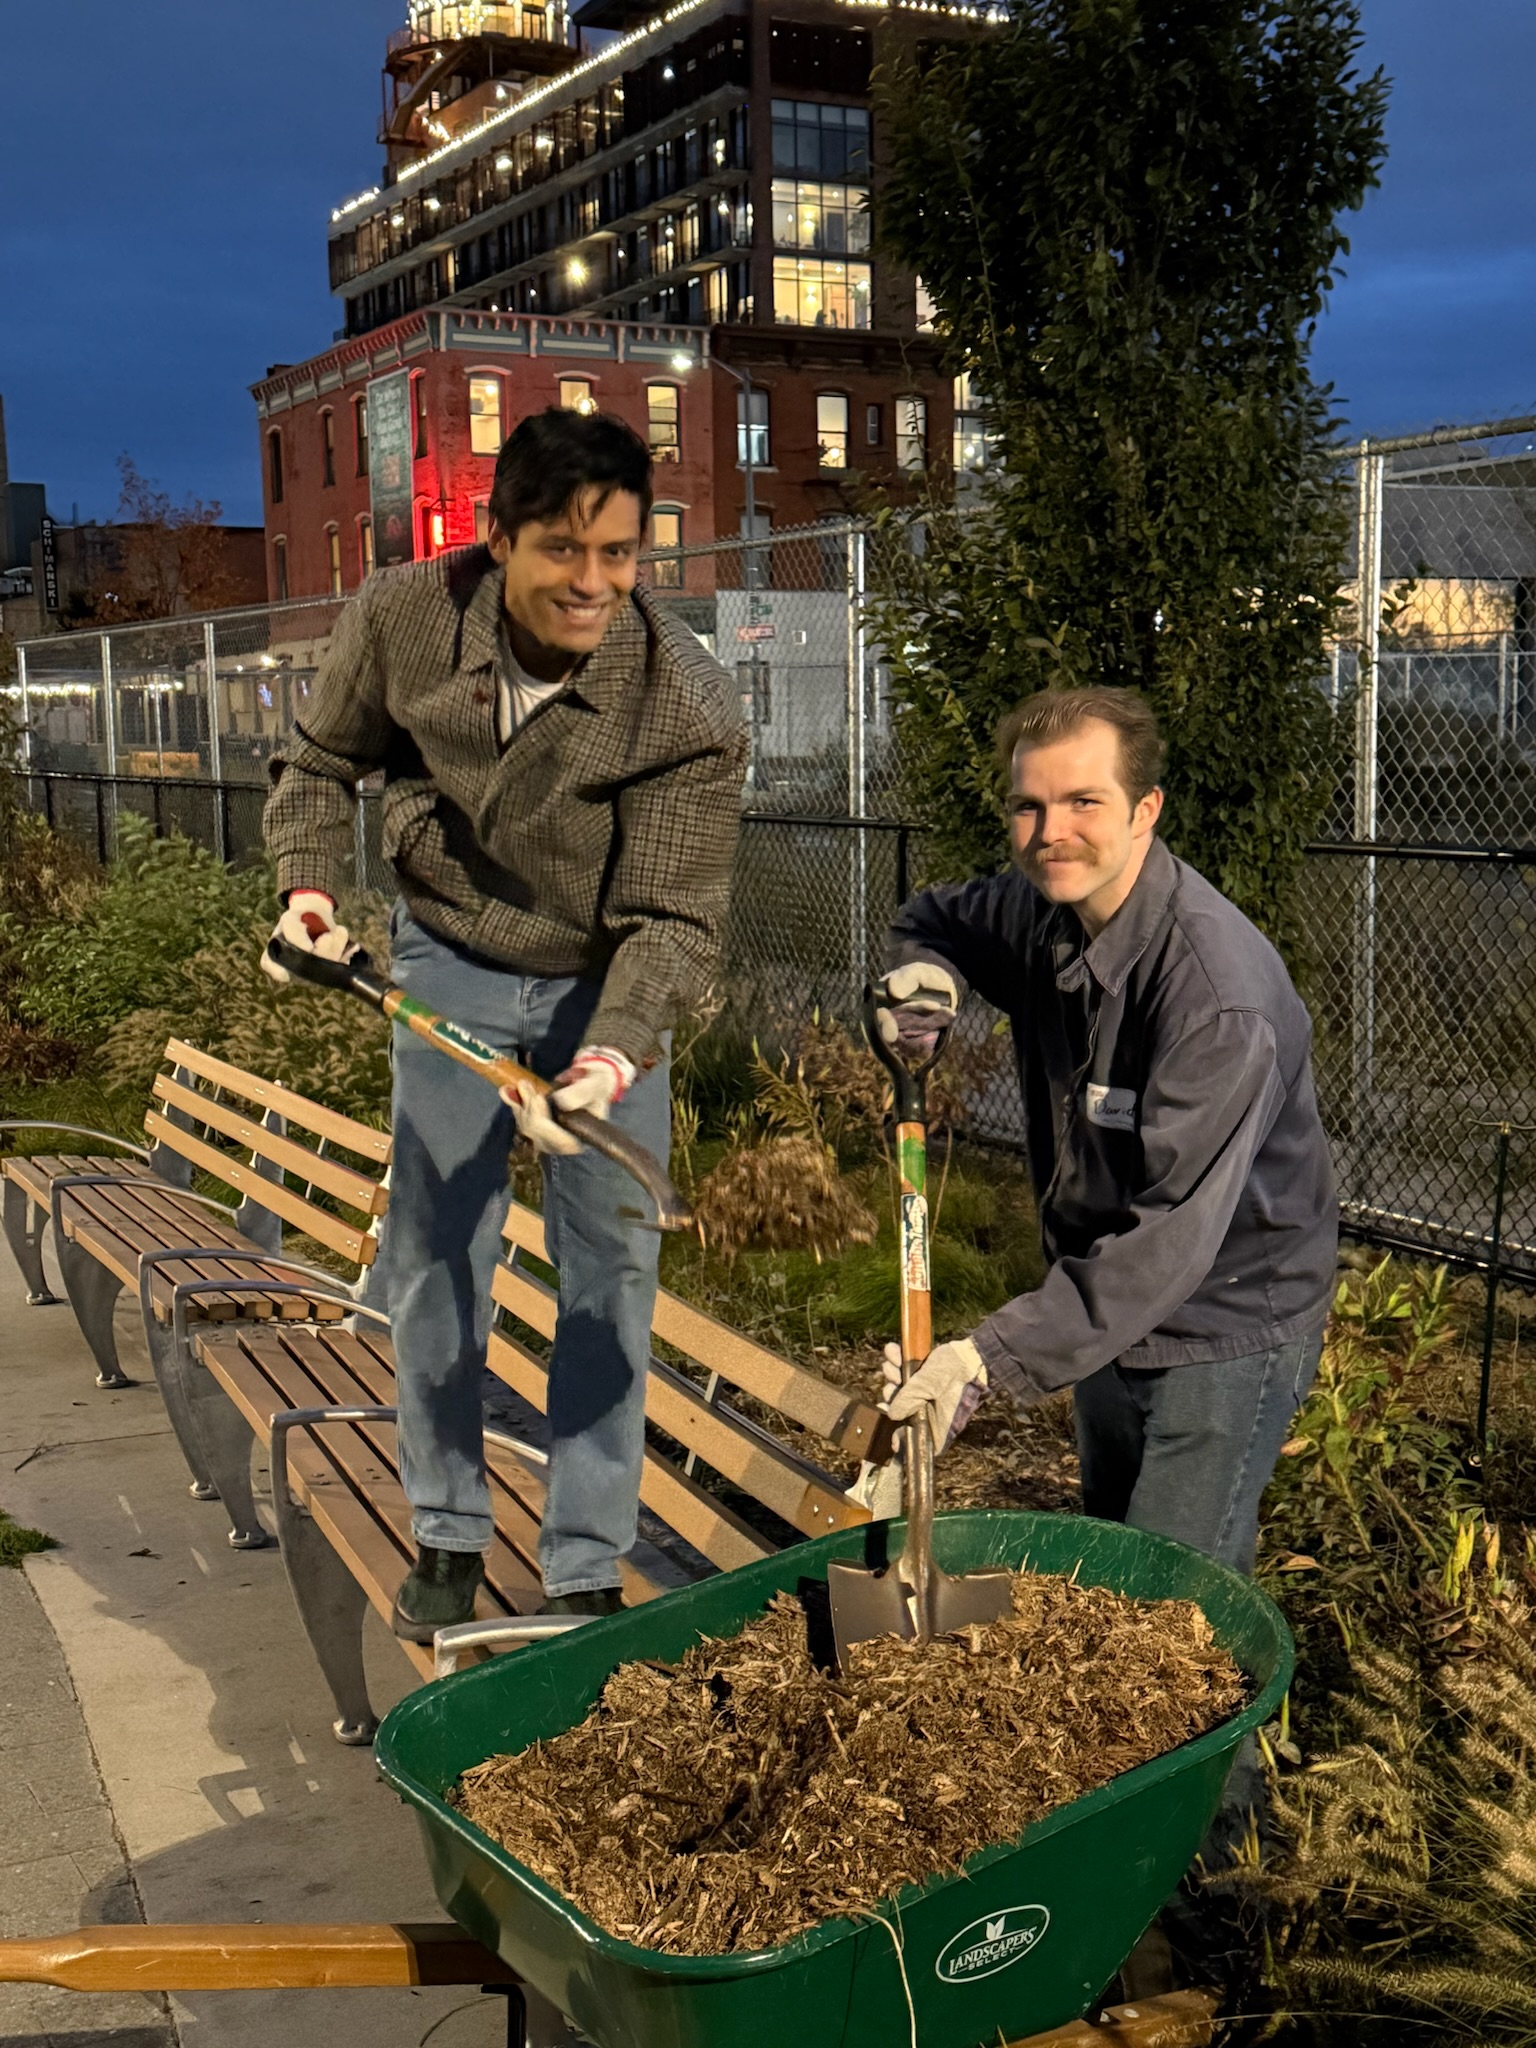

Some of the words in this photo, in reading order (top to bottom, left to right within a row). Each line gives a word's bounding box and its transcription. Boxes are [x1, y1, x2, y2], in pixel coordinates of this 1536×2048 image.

[42, 519, 56, 607] SCHIMANSKI
[948, 1926, 1037, 1976] LANDSCAPERS
[967, 1948, 1015, 1970] SELECT
